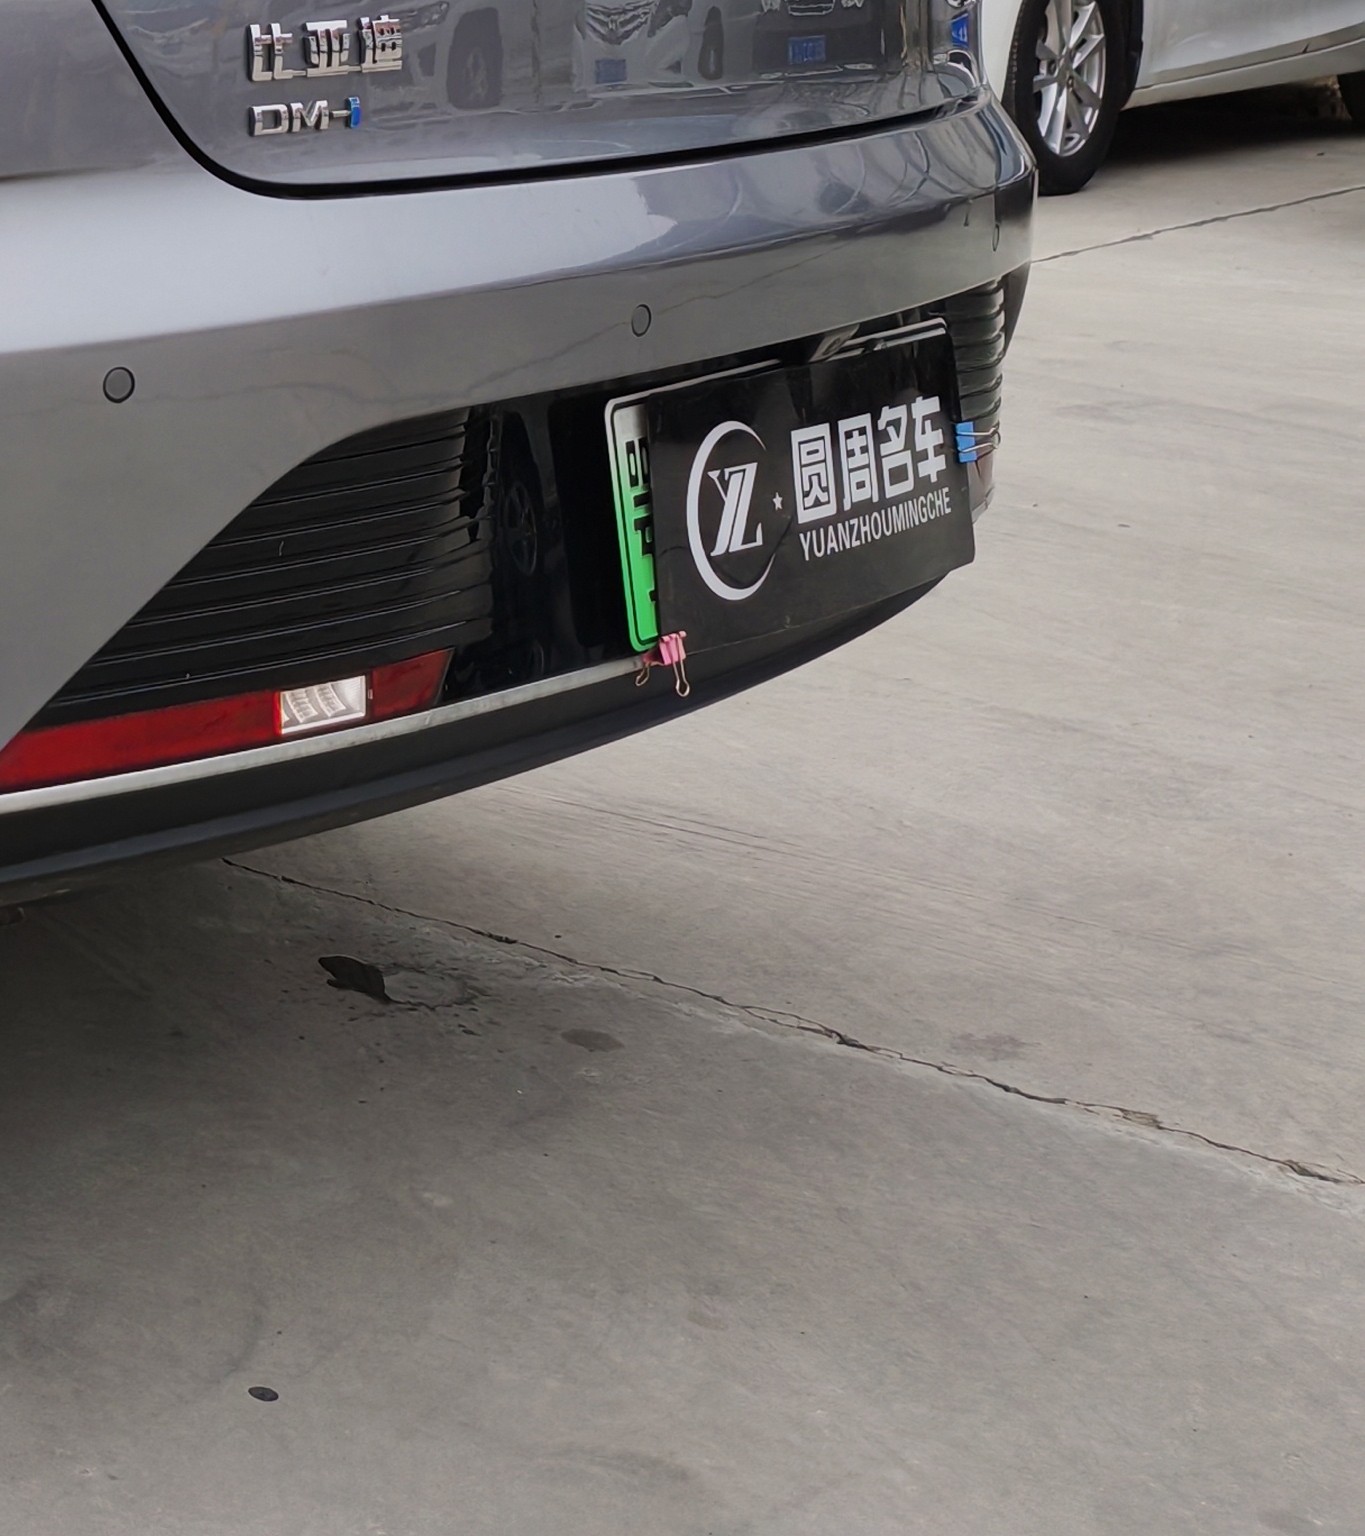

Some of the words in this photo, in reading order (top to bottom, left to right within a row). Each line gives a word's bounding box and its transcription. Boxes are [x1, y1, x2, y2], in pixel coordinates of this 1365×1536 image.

[248, 14, 403, 82] 比亚迪
[790, 395, 947, 525] 圆周名车
[799, 487, 952, 561] YUANZHOUMINGCHE
